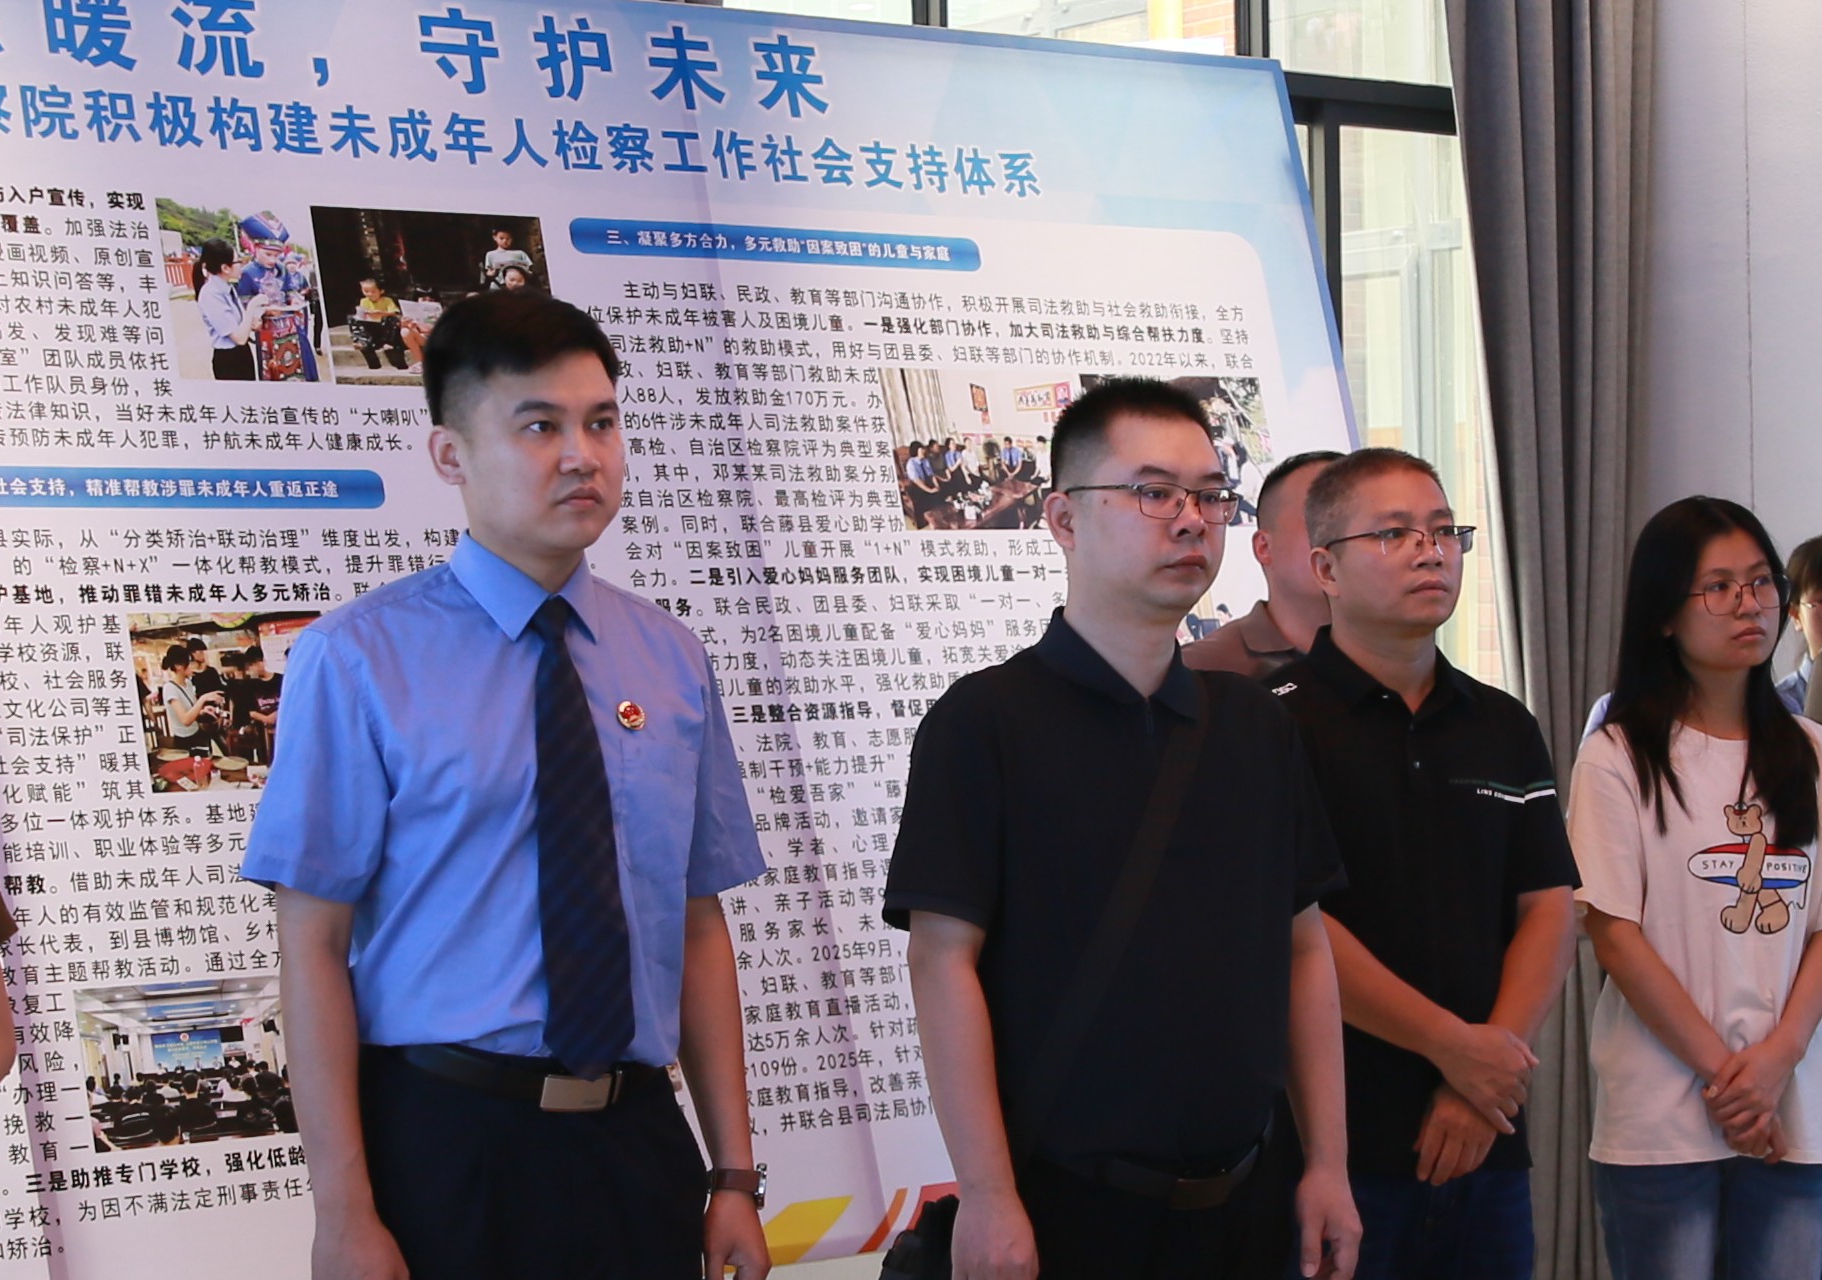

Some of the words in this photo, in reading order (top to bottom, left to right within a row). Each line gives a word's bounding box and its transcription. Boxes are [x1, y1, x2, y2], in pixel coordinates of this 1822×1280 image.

[621, 386, 884, 409] 人88人，发放救助金170万元。办
[619, 412, 888, 434] 的6件涉未成年人司法救助案件获
[628, 437, 892, 459] 高检、自治区检察院评为典型案
[624, 463, 896, 485] ，其中，邓某某司法救助案分别
[622, 515, 905, 535] 案例。同时，联合藤县爱心助学协
[630, 565, 1068, 588] 合力。二是引入爱心妈妈服务团队，实现困境儿童一对一
[689, 618, 1051, 644] 式，为2名困境儿童配备“爱心妈妈”服务团
[717, 670, 974, 698] 困儿童的救助水平，强化救助质
[740, 754, 911, 781] 强制干预+能力提升”
[757, 778, 909, 805] “检爱吾家”“藤
[768, 831, 898, 858] 、学者、心理
[1701, 859, 1735, 870] STAY
[1766, 861, 1808, 875] POSITIVE
[720, 886, 886, 916] 讲、亲子活动等9
[736, 938, 902, 970] 余人次。2025年9月，
[18, 1051, 80, 1075] 风险，
[746, 1072, 927, 1108] 庭教育指导，改善亲
[748, 1097, 934, 1137] ，并联合县司法局协
